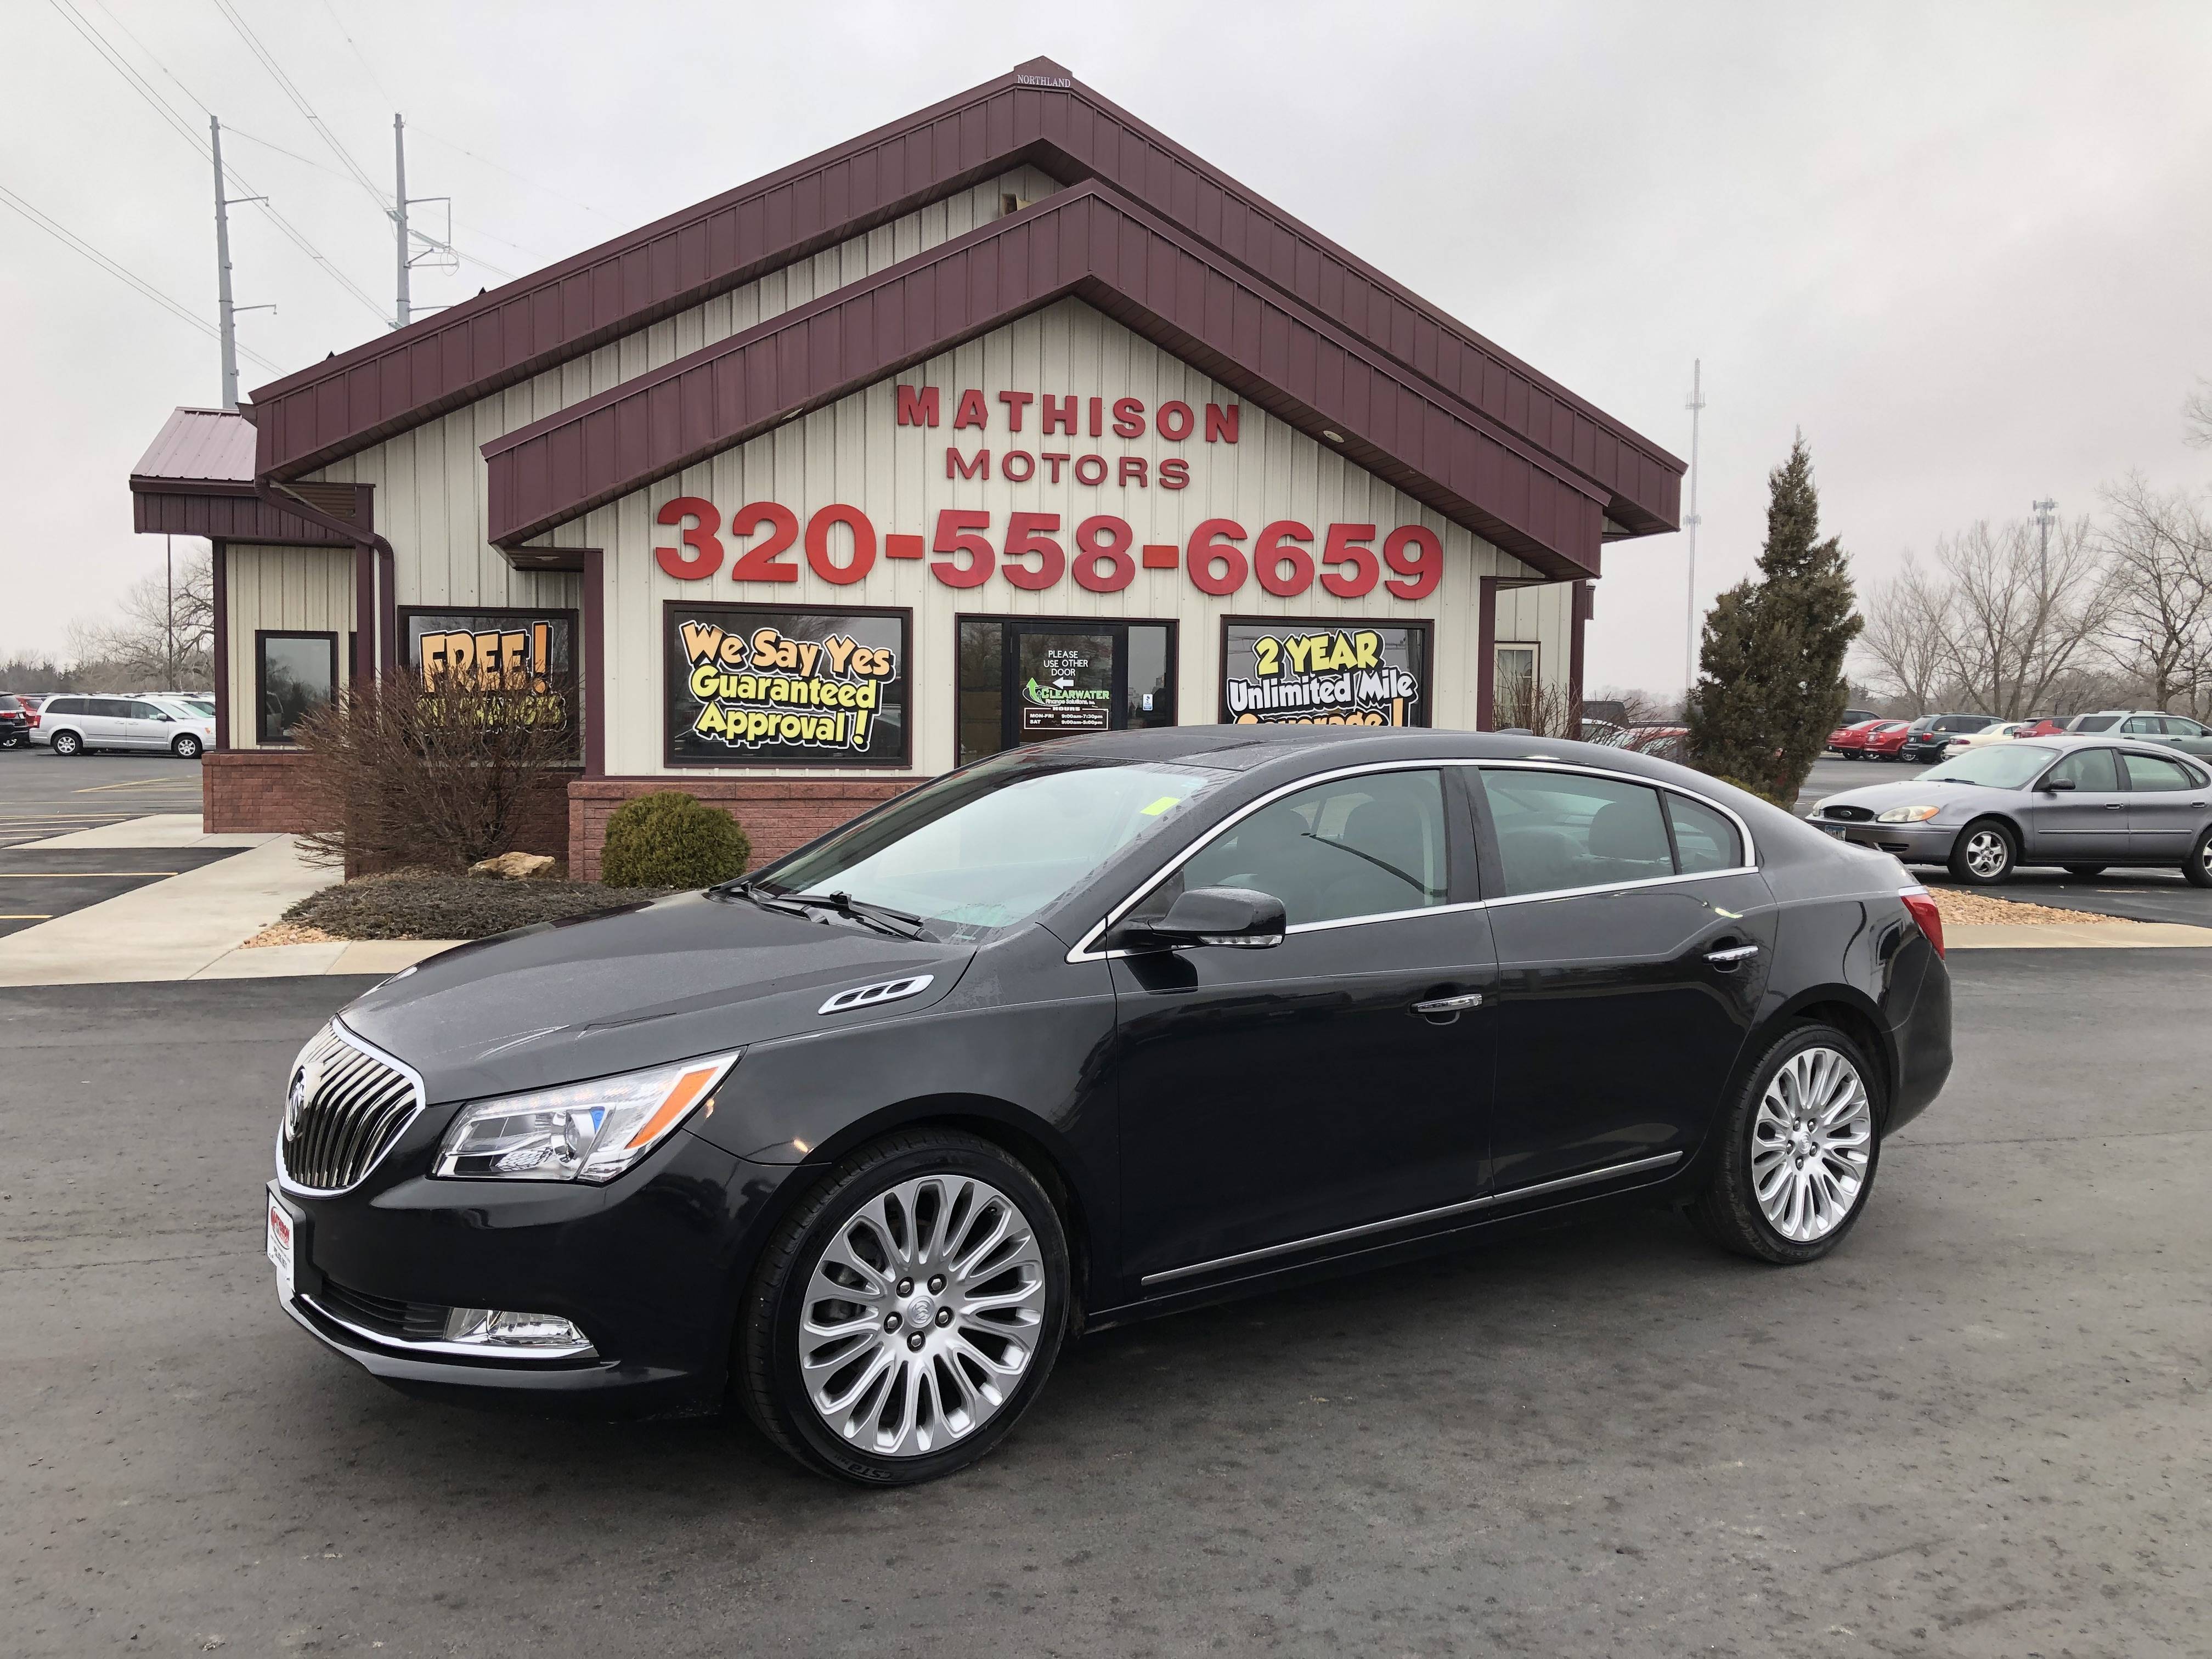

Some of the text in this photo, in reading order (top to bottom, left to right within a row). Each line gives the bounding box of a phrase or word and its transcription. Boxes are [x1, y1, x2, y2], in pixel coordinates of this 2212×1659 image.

[1017, 75, 1071, 87] NORTHLAND
[898, 385, 1238, 443] MATHISON
[947, 448, 1190, 489] MOTORS
[656, 496, 1443, 600] 320-558-6659
[420, 622, 551, 693] FREE!
[681, 622, 893, 677] We Say Yes
[1043, 659, 1088, 668] USE OTHER
[1048, 650, 1079, 658] PLEASE
[1254, 630, 1380, 676] 2 YEAR
[691, 665, 877, 709] Guaranteed
[1051, 668, 1076, 676] DOOR
[1229, 669, 1414, 712] Unlimited Mile
